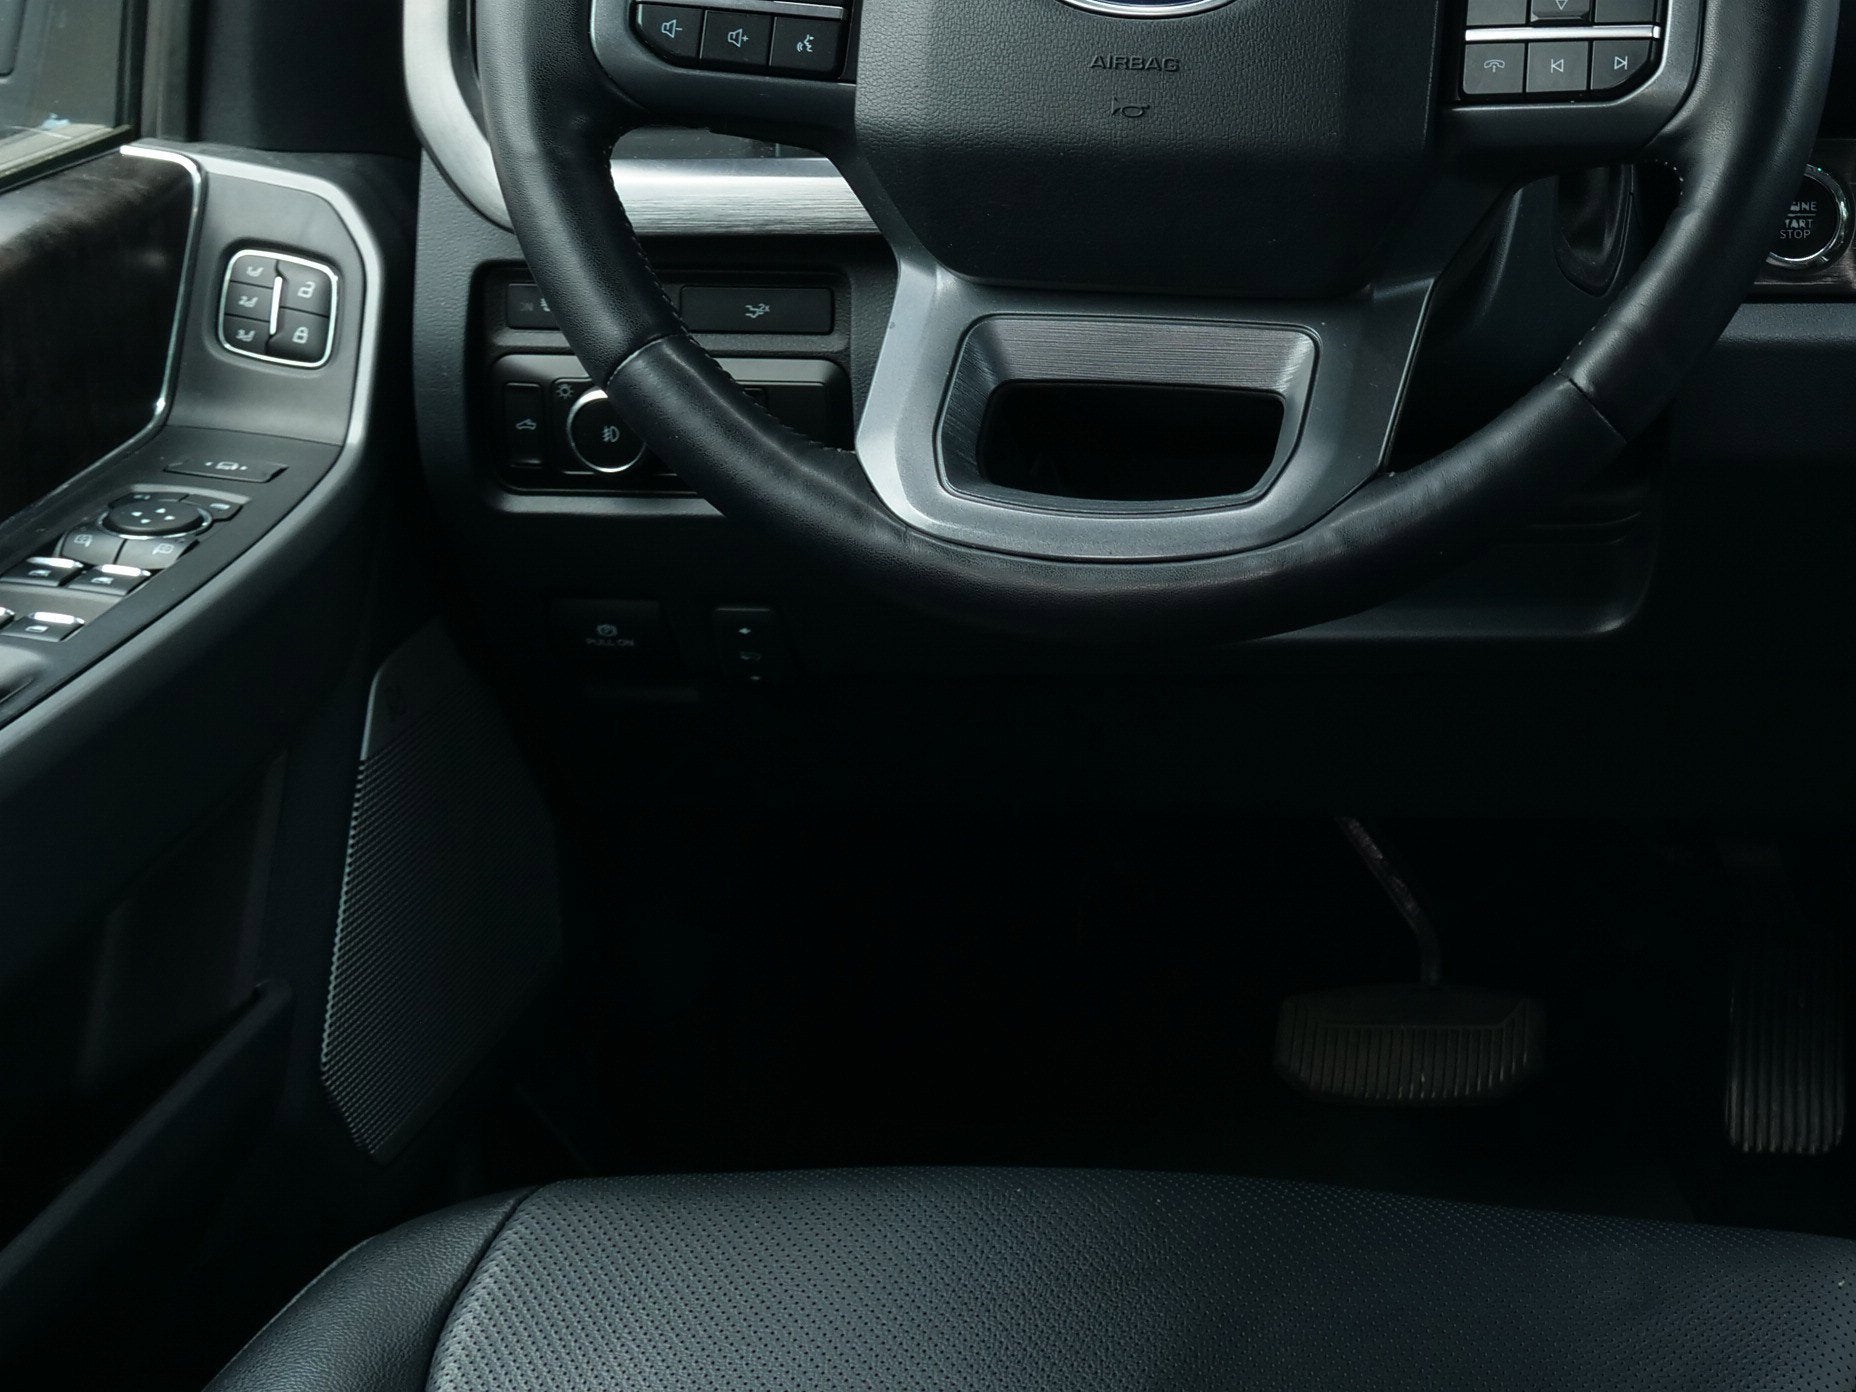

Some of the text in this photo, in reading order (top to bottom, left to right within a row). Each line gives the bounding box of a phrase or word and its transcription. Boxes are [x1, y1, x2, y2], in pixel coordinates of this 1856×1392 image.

[1090, 55, 1181, 72] AIRBAG
[1784, 219, 1814, 228] TART
[1780, 229, 1811, 239] STOP
